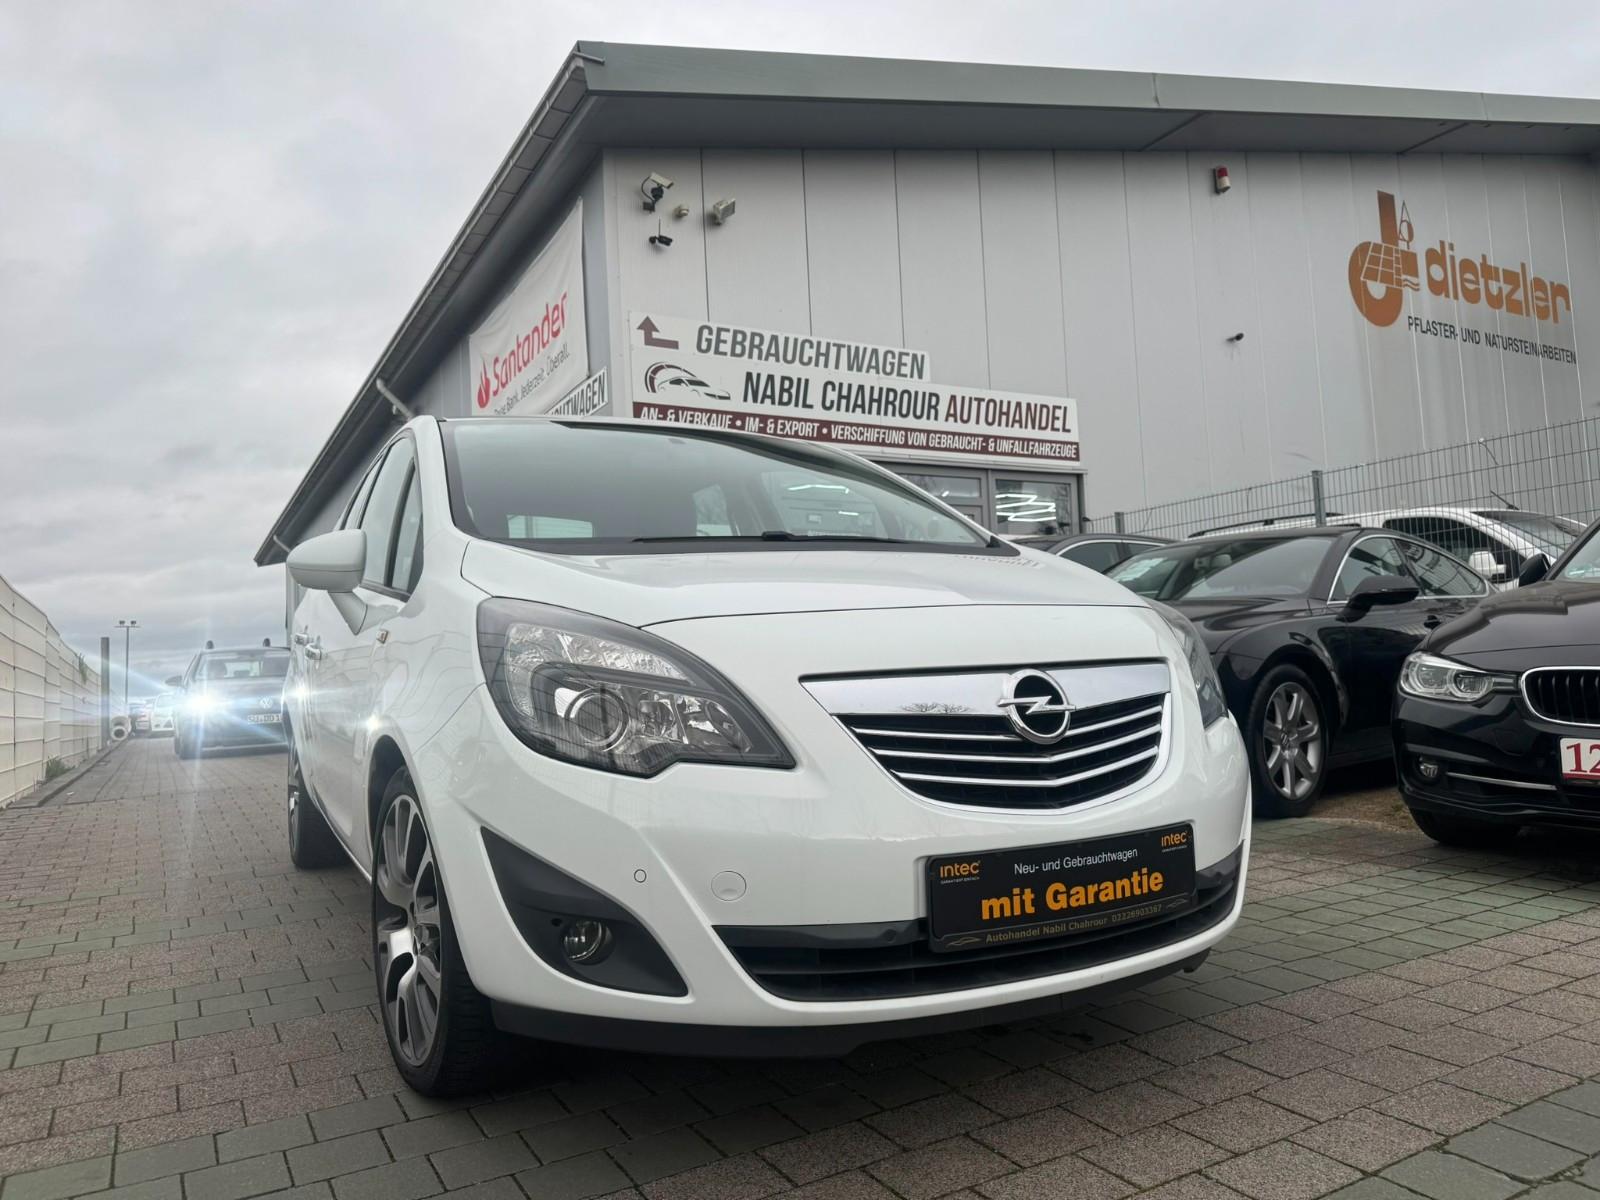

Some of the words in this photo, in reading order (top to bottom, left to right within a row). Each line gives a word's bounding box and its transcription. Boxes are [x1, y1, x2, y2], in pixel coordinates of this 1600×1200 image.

[1424, 240, 1571, 324] dietzler
[492, 291, 567, 397] Santander
[696, 325, 925, 380] GEBRAUCHTWAGEN
[1407, 316, 1459, 340] PFLASTER-
[1460, 327, 1481, 345] UND
[1485, 333, 1577, 364] NATURSTEINARBEITEN
[742, 371, 814, 409] NABIL
[821, 381, 940, 422] CHAHROUR
[944, 395, 1071, 433] AUTOHANDEL
[639, 406, 664, 421] AN-
[667, 409, 678, 422] &
[678, 410, 733, 429] VERKAUF
[744, 416, 763, 432] IM-
[766, 420, 776, 433] &
[776, 421, 819, 437] EXPORT
[831, 425, 905, 445] VERSCHIFFUNG
[907, 432, 929, 447] VON
[929, 433, 986, 451] GEBRAUCHT-
[988, 438, 995, 451] &
[996, 440, 1077, 458] UNFALLFAHRZEUGE
[1014, 863, 1040, 875] Neu-
[1042, 858, 1060, 871] und
[1063, 848, 1138, 869] Gebrauchtwagen
[1161, 832, 1187, 848] intec
[940, 862, 980, 878] intec
[981, 887, 1035, 920] mit
[1045, 867, 1165, 912] Garantie
[985, 926, 1040, 944] Autohandel
[1043, 922, 1067, 935] Nabil
[1069, 916, 1108, 931] Chahrour
